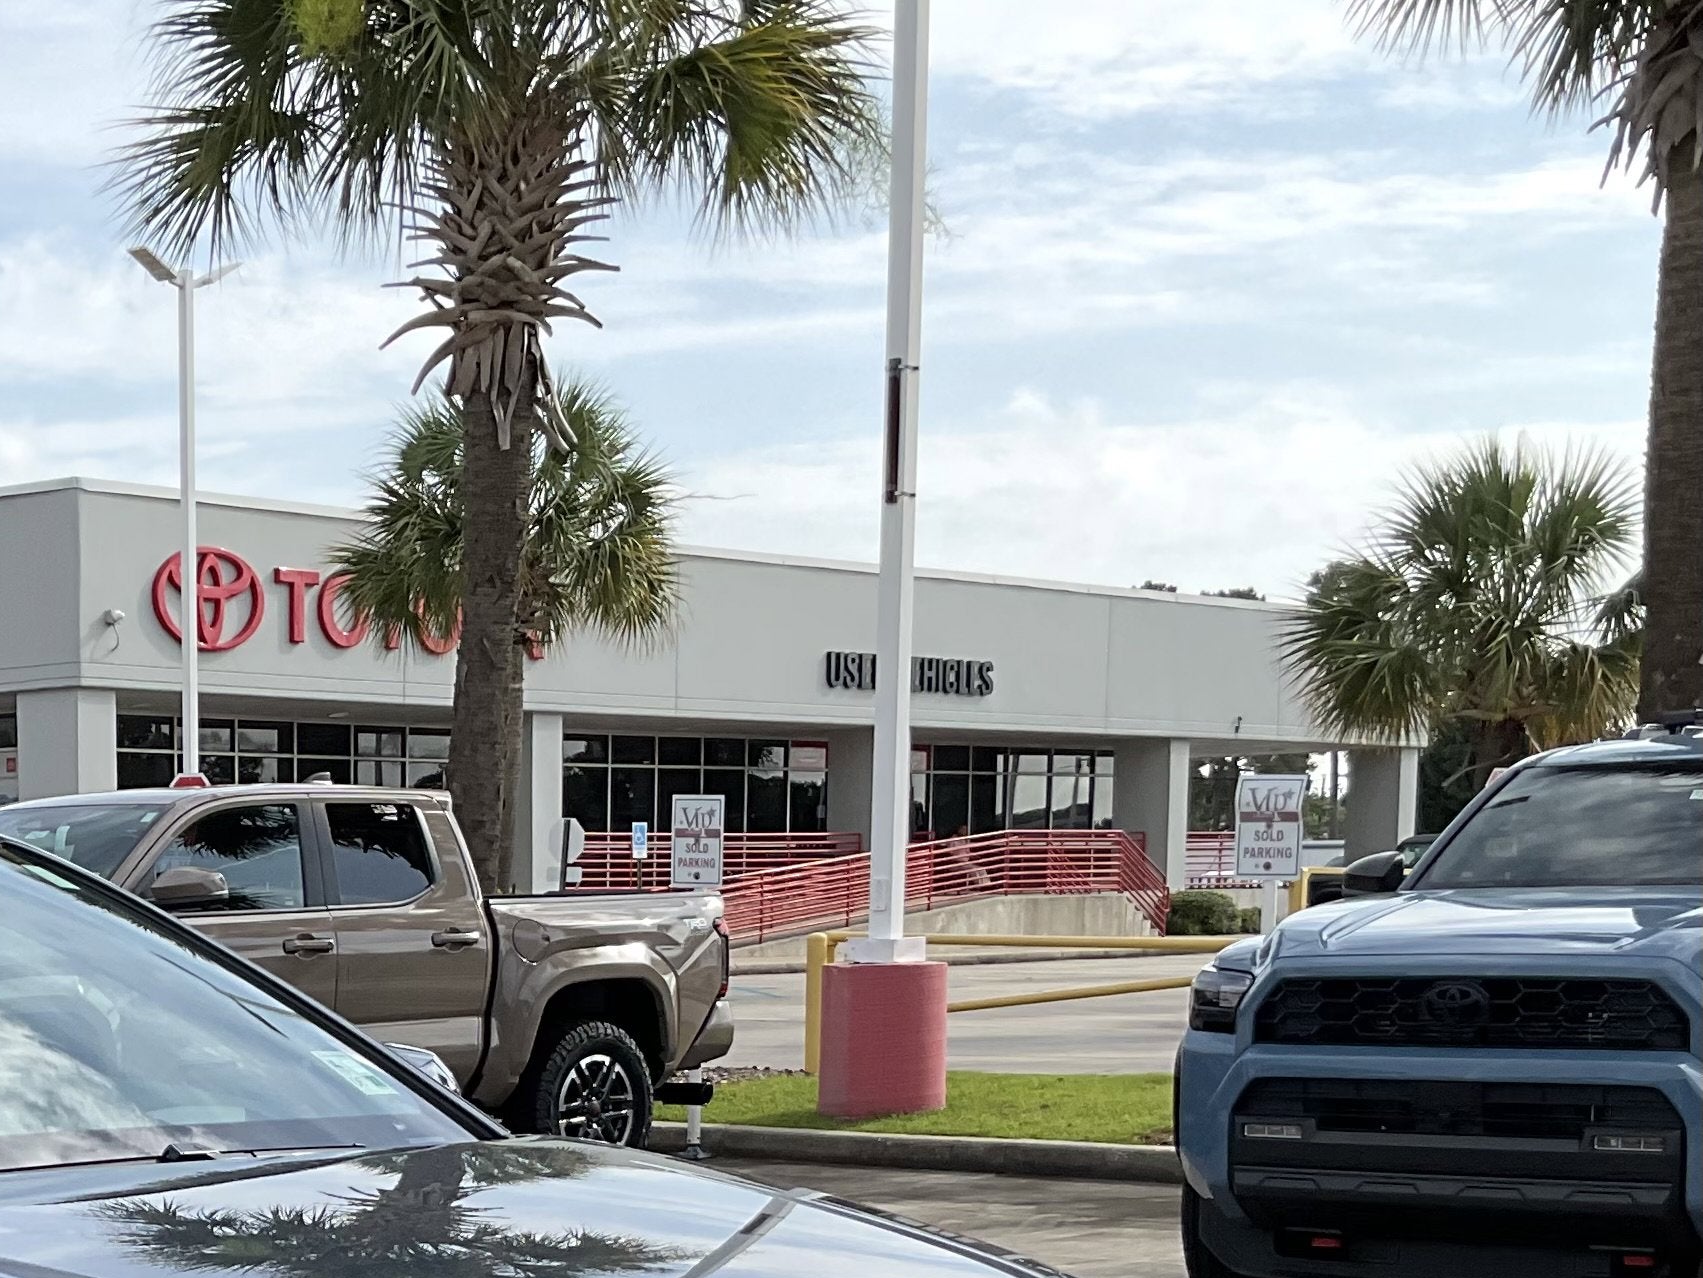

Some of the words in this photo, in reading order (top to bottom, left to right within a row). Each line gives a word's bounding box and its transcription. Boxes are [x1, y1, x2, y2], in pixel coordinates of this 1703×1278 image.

[826, 651, 876, 690] USE
[911, 656, 993, 696] EHICLES
[1254, 830, 1284, 841] SOLD
[685, 843, 709, 854] SOLD
[1242, 846, 1293, 859] PARKING
[677, 857, 716, 869] PARKING
